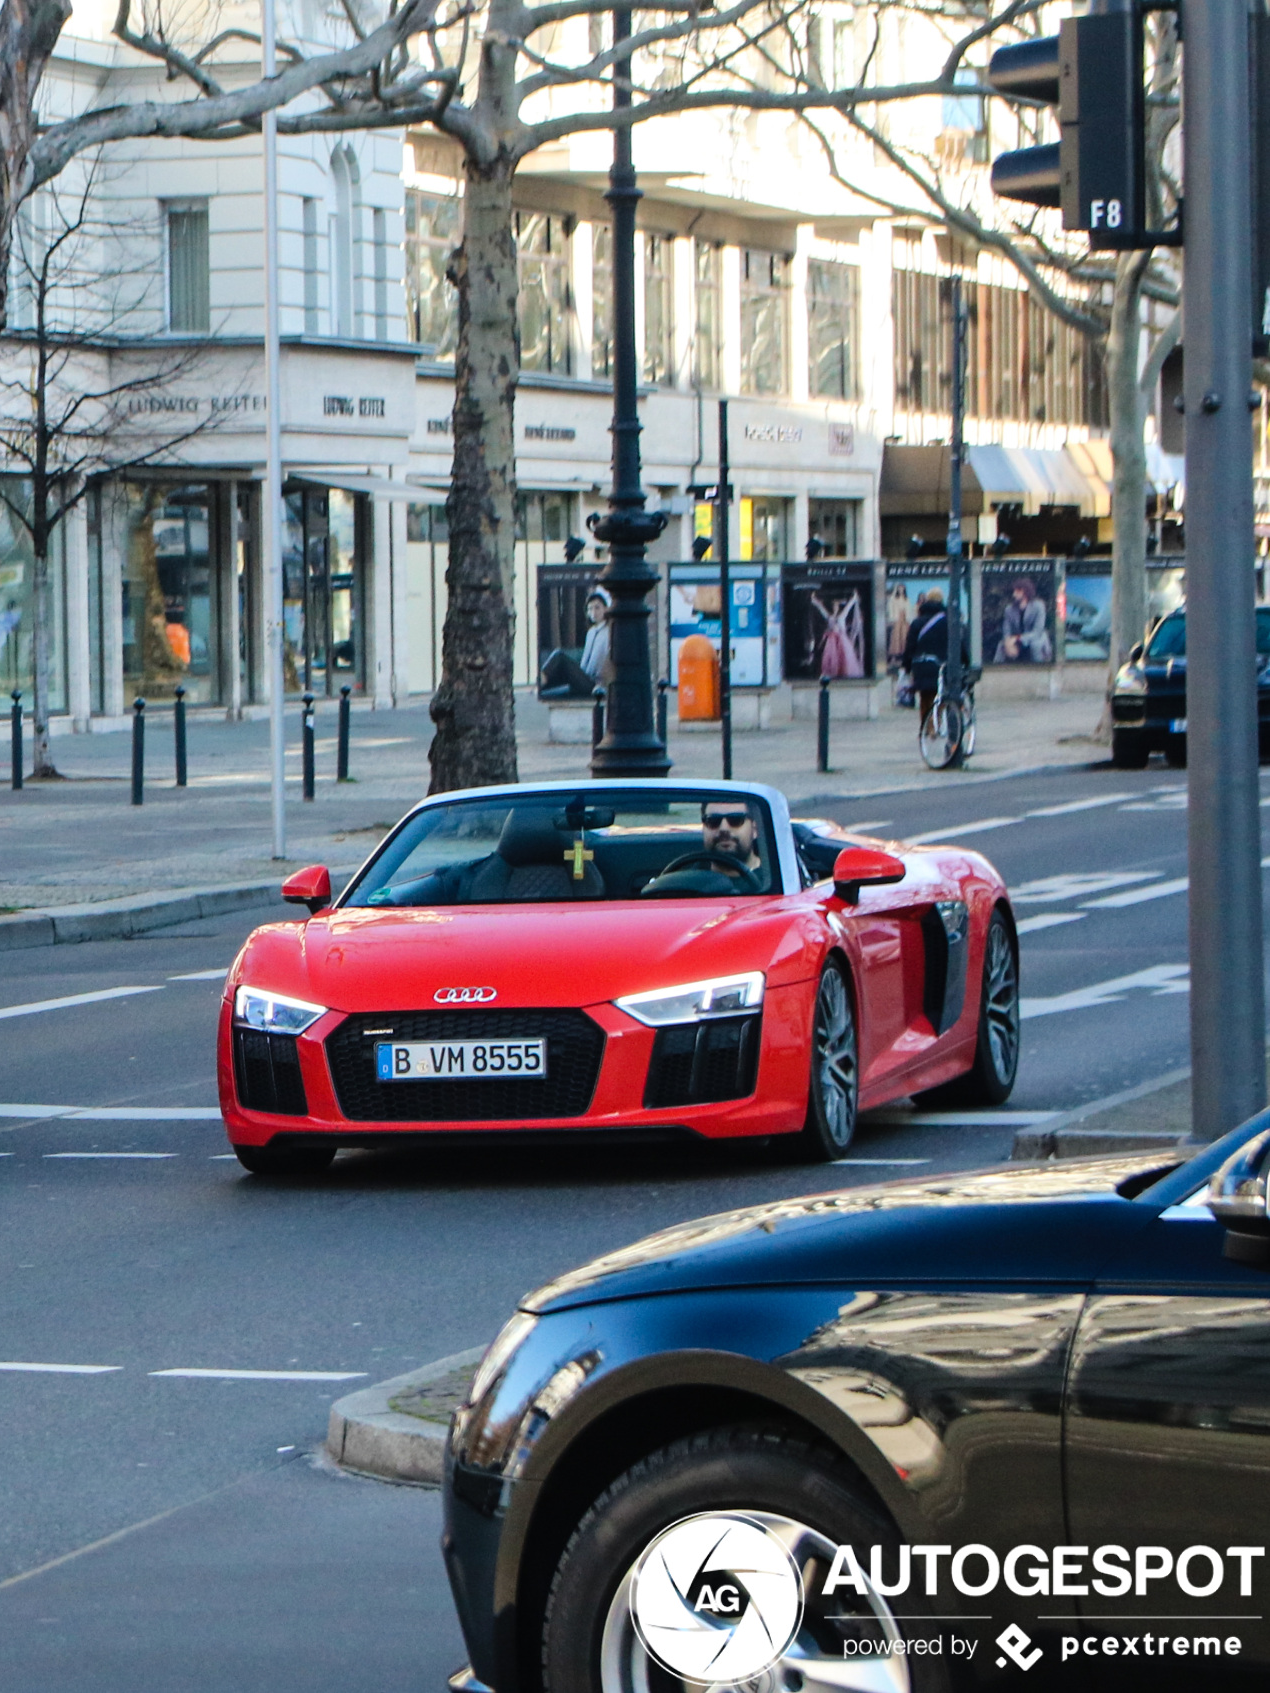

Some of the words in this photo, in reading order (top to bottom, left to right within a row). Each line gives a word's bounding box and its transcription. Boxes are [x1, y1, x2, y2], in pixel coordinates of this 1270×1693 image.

[1091, 199, 1121, 228] F8
[129, 396, 199, 412] LUDWIG
[210, 395, 266, 411] REITE
[395, 1048, 411, 1074] B
[430, 1046, 464, 1073] VM
[472, 1044, 540, 1072] 8555
